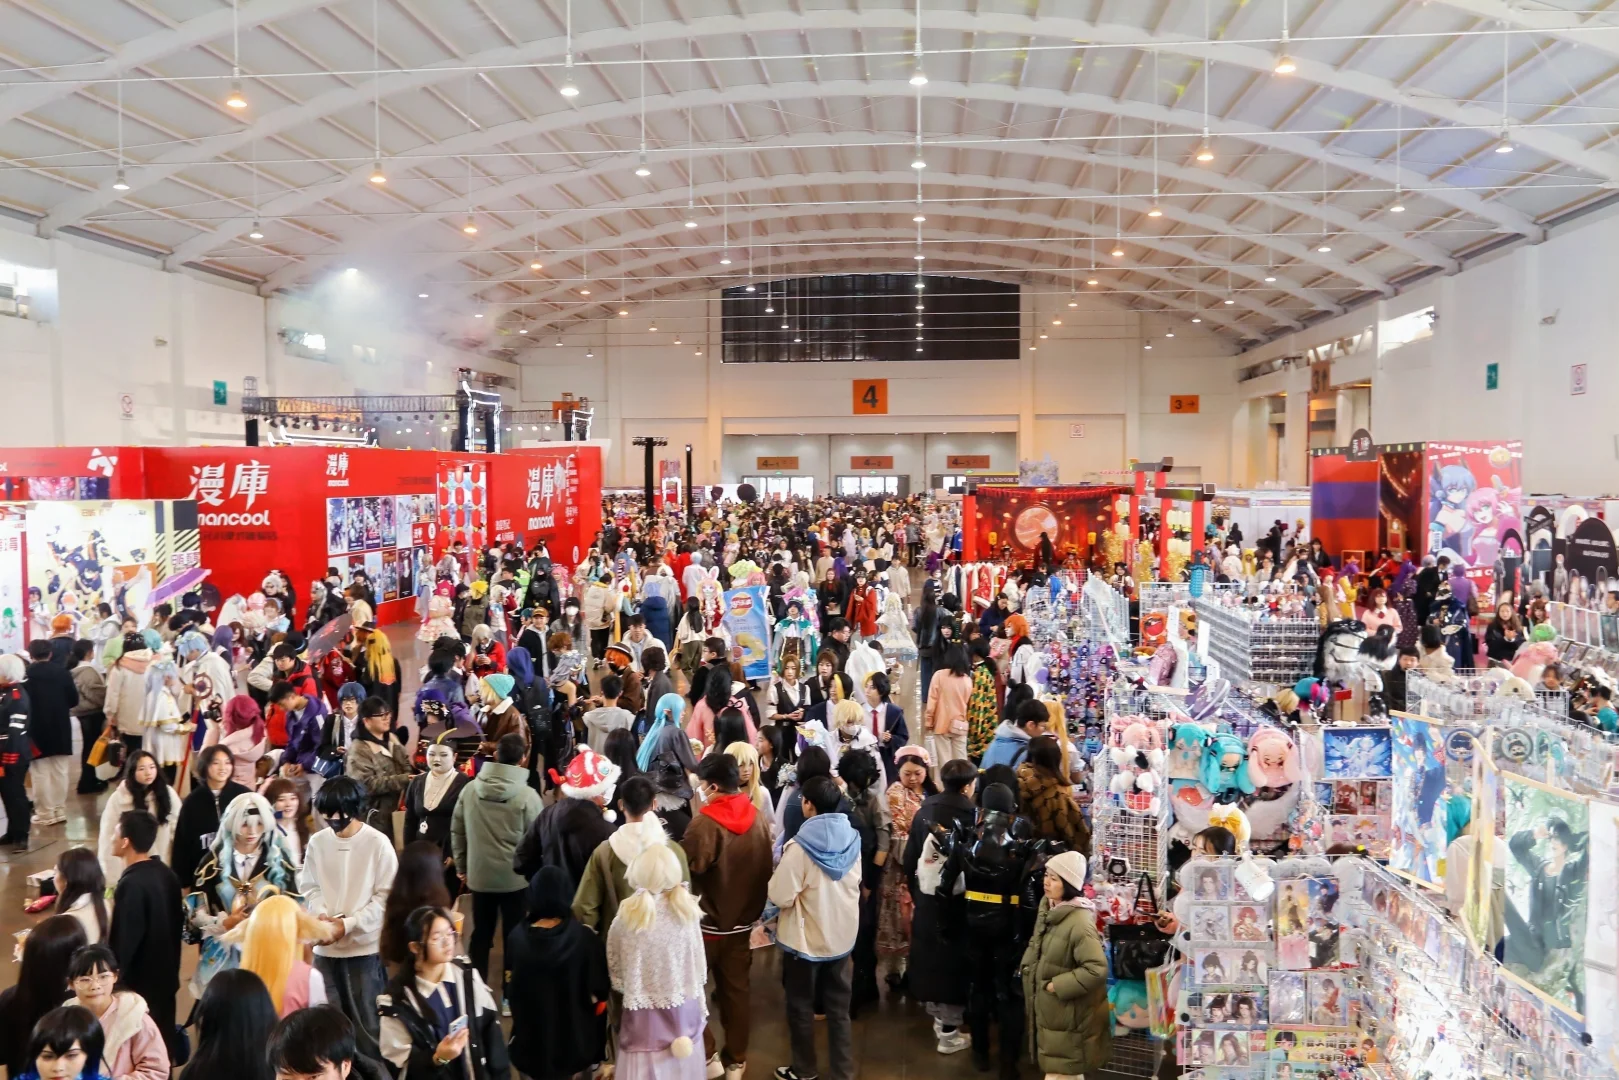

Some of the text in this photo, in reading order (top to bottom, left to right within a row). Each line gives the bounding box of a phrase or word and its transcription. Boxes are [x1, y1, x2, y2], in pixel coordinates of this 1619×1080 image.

[862, 384, 879, 408] 4
[1175, 399, 1182, 410] 3
[182, 459, 271, 511] 漫庫
